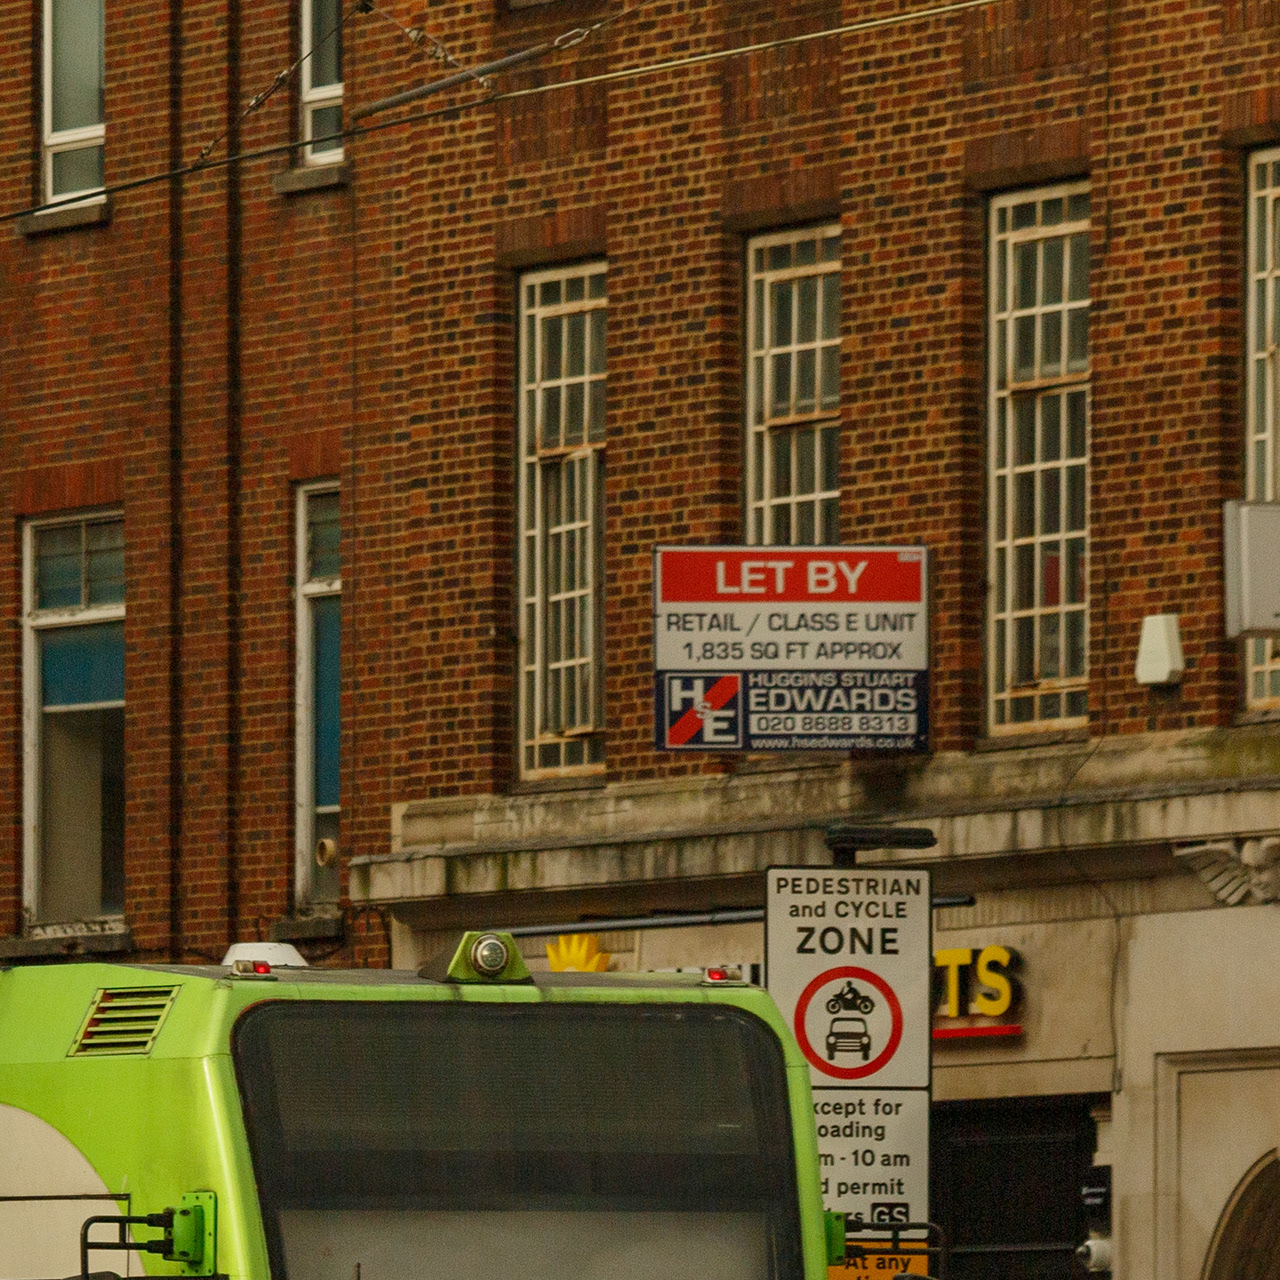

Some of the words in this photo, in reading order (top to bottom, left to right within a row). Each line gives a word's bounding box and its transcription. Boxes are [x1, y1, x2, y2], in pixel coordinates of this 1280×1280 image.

[716, 561, 794, 594] LET
[807, 561, 868, 594] BY
[666, 613, 740, 632] RETAIL
[768, 613, 838, 632] CLASS
[845, 613, 858, 632] E
[865, 613, 917, 632] UNIT
[683, 642, 744, 662] 1,835
[750, 642, 778, 661] SQ
[786, 642, 808, 660] FT
[816, 642, 901, 660] APPROX
[749, 673, 837, 687] HUGGINS
[841, 673, 917, 687] STUART
[749, 688, 918, 711] EDWARDS
[757, 716, 795, 731] 020
[859, 716, 909, 731] 8313
[776, 877, 920, 895] PEDESTRIAN
[789, 901, 826, 917] and
[835, 901, 907, 918] CYCLE
[796, 926, 899, 955] ZONE
[934, 945, 1011, 1018] TS
[813, 1099, 866, 1118] xcept
[874, 1098, 902, 1115] for
[818, 1121, 885, 1141] oading
[852, 1150, 874, 1166] 10
[881, 1154, 910, 1166] am
[837, 1178, 904, 1197] permit
[845, 1256, 868, 1270] At
[876, 1257, 911, 1273] any
